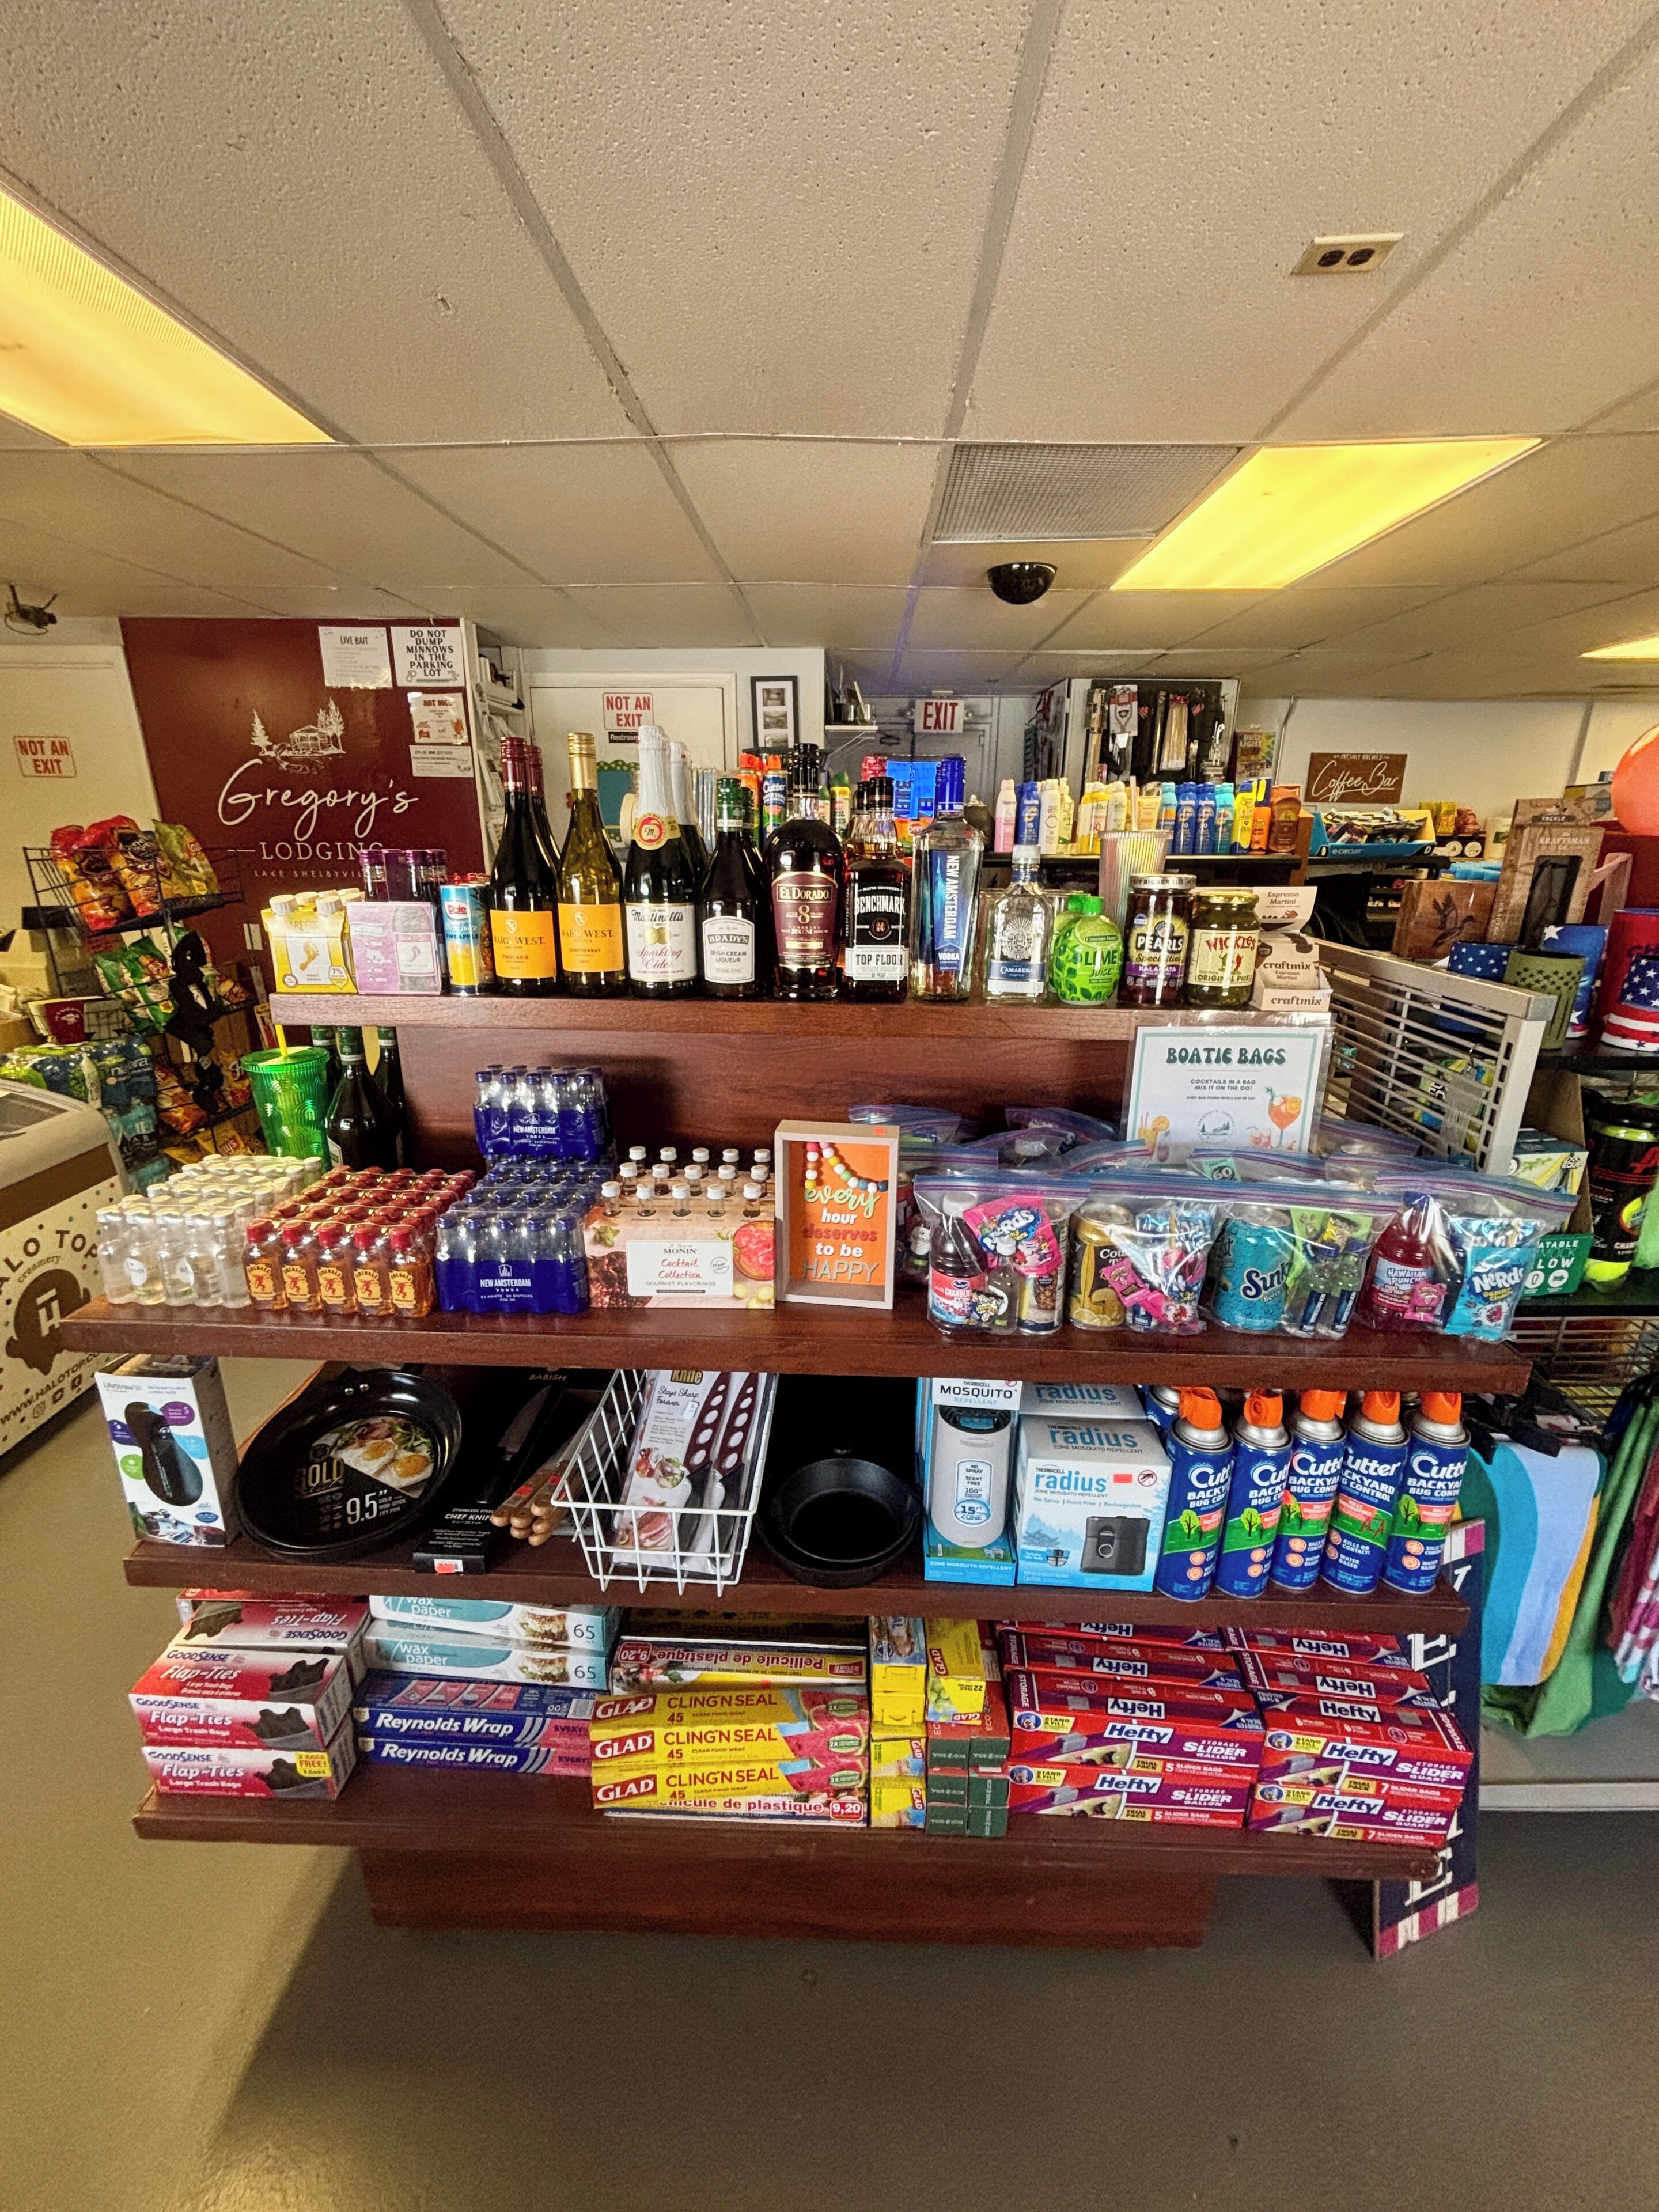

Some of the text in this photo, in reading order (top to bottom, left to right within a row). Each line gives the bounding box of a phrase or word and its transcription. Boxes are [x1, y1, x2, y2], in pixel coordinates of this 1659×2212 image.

[340, 636, 368, 645] LIVE BAIT
[410, 630, 446, 638] DO NOT
[406, 645, 454, 653] MINNOWS
[429, 653, 446, 661] THE
[410, 661, 453, 669] PARKING
[423, 669, 441, 677] LOT
[606, 696, 650, 710] NOT AN
[616, 713, 643, 727] EXIT
[923, 700, 959, 732] EXIT
[18, 740, 69, 755] NOT AN
[32, 759, 62, 774] EXIT
[1312, 760, 1400, 802] Coffee Bar
[218, 759, 419, 841] Gregory's
[779, 887, 830, 900] EL DORADO
[944, 855, 960, 939] NEW AMSTERDAM
[448, 904, 467, 914] Dole
[855, 895, 906, 915] BENCHMARK
[798, 905, 810, 924] 8
[515, 937, 546, 945] WEST
[584, 930, 613, 938] WEST
[709, 935, 749, 944] BRADY'S
[1137, 935, 1183, 951] PEARLS
[856, 954, 903, 965] TOP FLOOR
[1085, 950, 1118, 966] LIME
[1263, 961, 1311, 971] craftmix
[1088, 969, 1112, 978] JUICE
[1271, 995, 1323, 1005] craftmix
[1166, 1047, 1287, 1066] BOATIE BAGS
[513, 1126, 524, 1134] NEW
[804, 1185, 881, 1219] every
[821, 1207, 858, 1225] hour
[802, 1222, 877, 1242] deserves
[815, 1242, 863, 1257] to be
[18, 1255, 62, 1283] creamery
[661, 1258, 699, 1267] Cocktail
[658, 1270, 703, 1279] Collection
[802, 1259, 880, 1283] HAPPY
[1387, 1268, 1427, 1277] HAWAIIAN
[480, 1278, 532, 1287] NEW AMSTERDAM
[657, 1386, 700, 1399] Stays Sharp
[940, 1385, 1013, 1399] MOSQUITO
[1035, 1384, 1116, 1401] radius
[656, 1396, 680, 1407] Forever
[1049, 1427, 1138, 1448] radius
[1035, 1470, 1107, 1493] radius
[1350, 1479, 1391, 1502] CONTROL
[961, 1505, 976, 1514] 15
[1343, 1539, 1359, 1547] KILLS
[1339, 1559, 1358, 1569] BASED
[1340, 1553, 1360, 1565] WATER
[412, 1604, 451, 1619] paper
[271, 1611, 347, 1627] Flap-Ties
[574, 1624, 595, 1639] 65
[401, 1644, 429, 1656] wax
[621, 1647, 648, 1661] 9,20
[656, 1649, 728, 1664] plastique
[733, 1651, 752, 1662] de
[406, 1653, 448, 1666] paper
[756, 1653, 823, 1670] Pellicule
[931, 1649, 946, 1675] GLAD
[160, 1665, 243, 1681] Flap-Ties
[574, 1665, 597, 1680] 65
[734, 1693, 778, 1706] SEAL
[596, 1696, 654, 1719] GLAD
[150, 1711, 232, 1726] Flap-Ties
[953, 1713, 980, 1721] GLAD
[184, 1727, 209, 1735] Trash
[375, 1713, 514, 1737] Reynolds Wrap
[1438, 1712, 1467, 1751] STORAGE
[594, 1734, 653, 1758] GLAD
[1182, 1741, 1247, 1757] SLIDER
[1201, 1740, 1240, 1748] STORAGE
[1196, 1752, 1236, 1761] GALLON
[299, 1760, 327, 1768] FREE!
[1165, 1763, 1175, 1772] 5
[1410, 1774, 1448, 1783] QUART
[722, 1800, 861, 1815] de plastique 9,20
